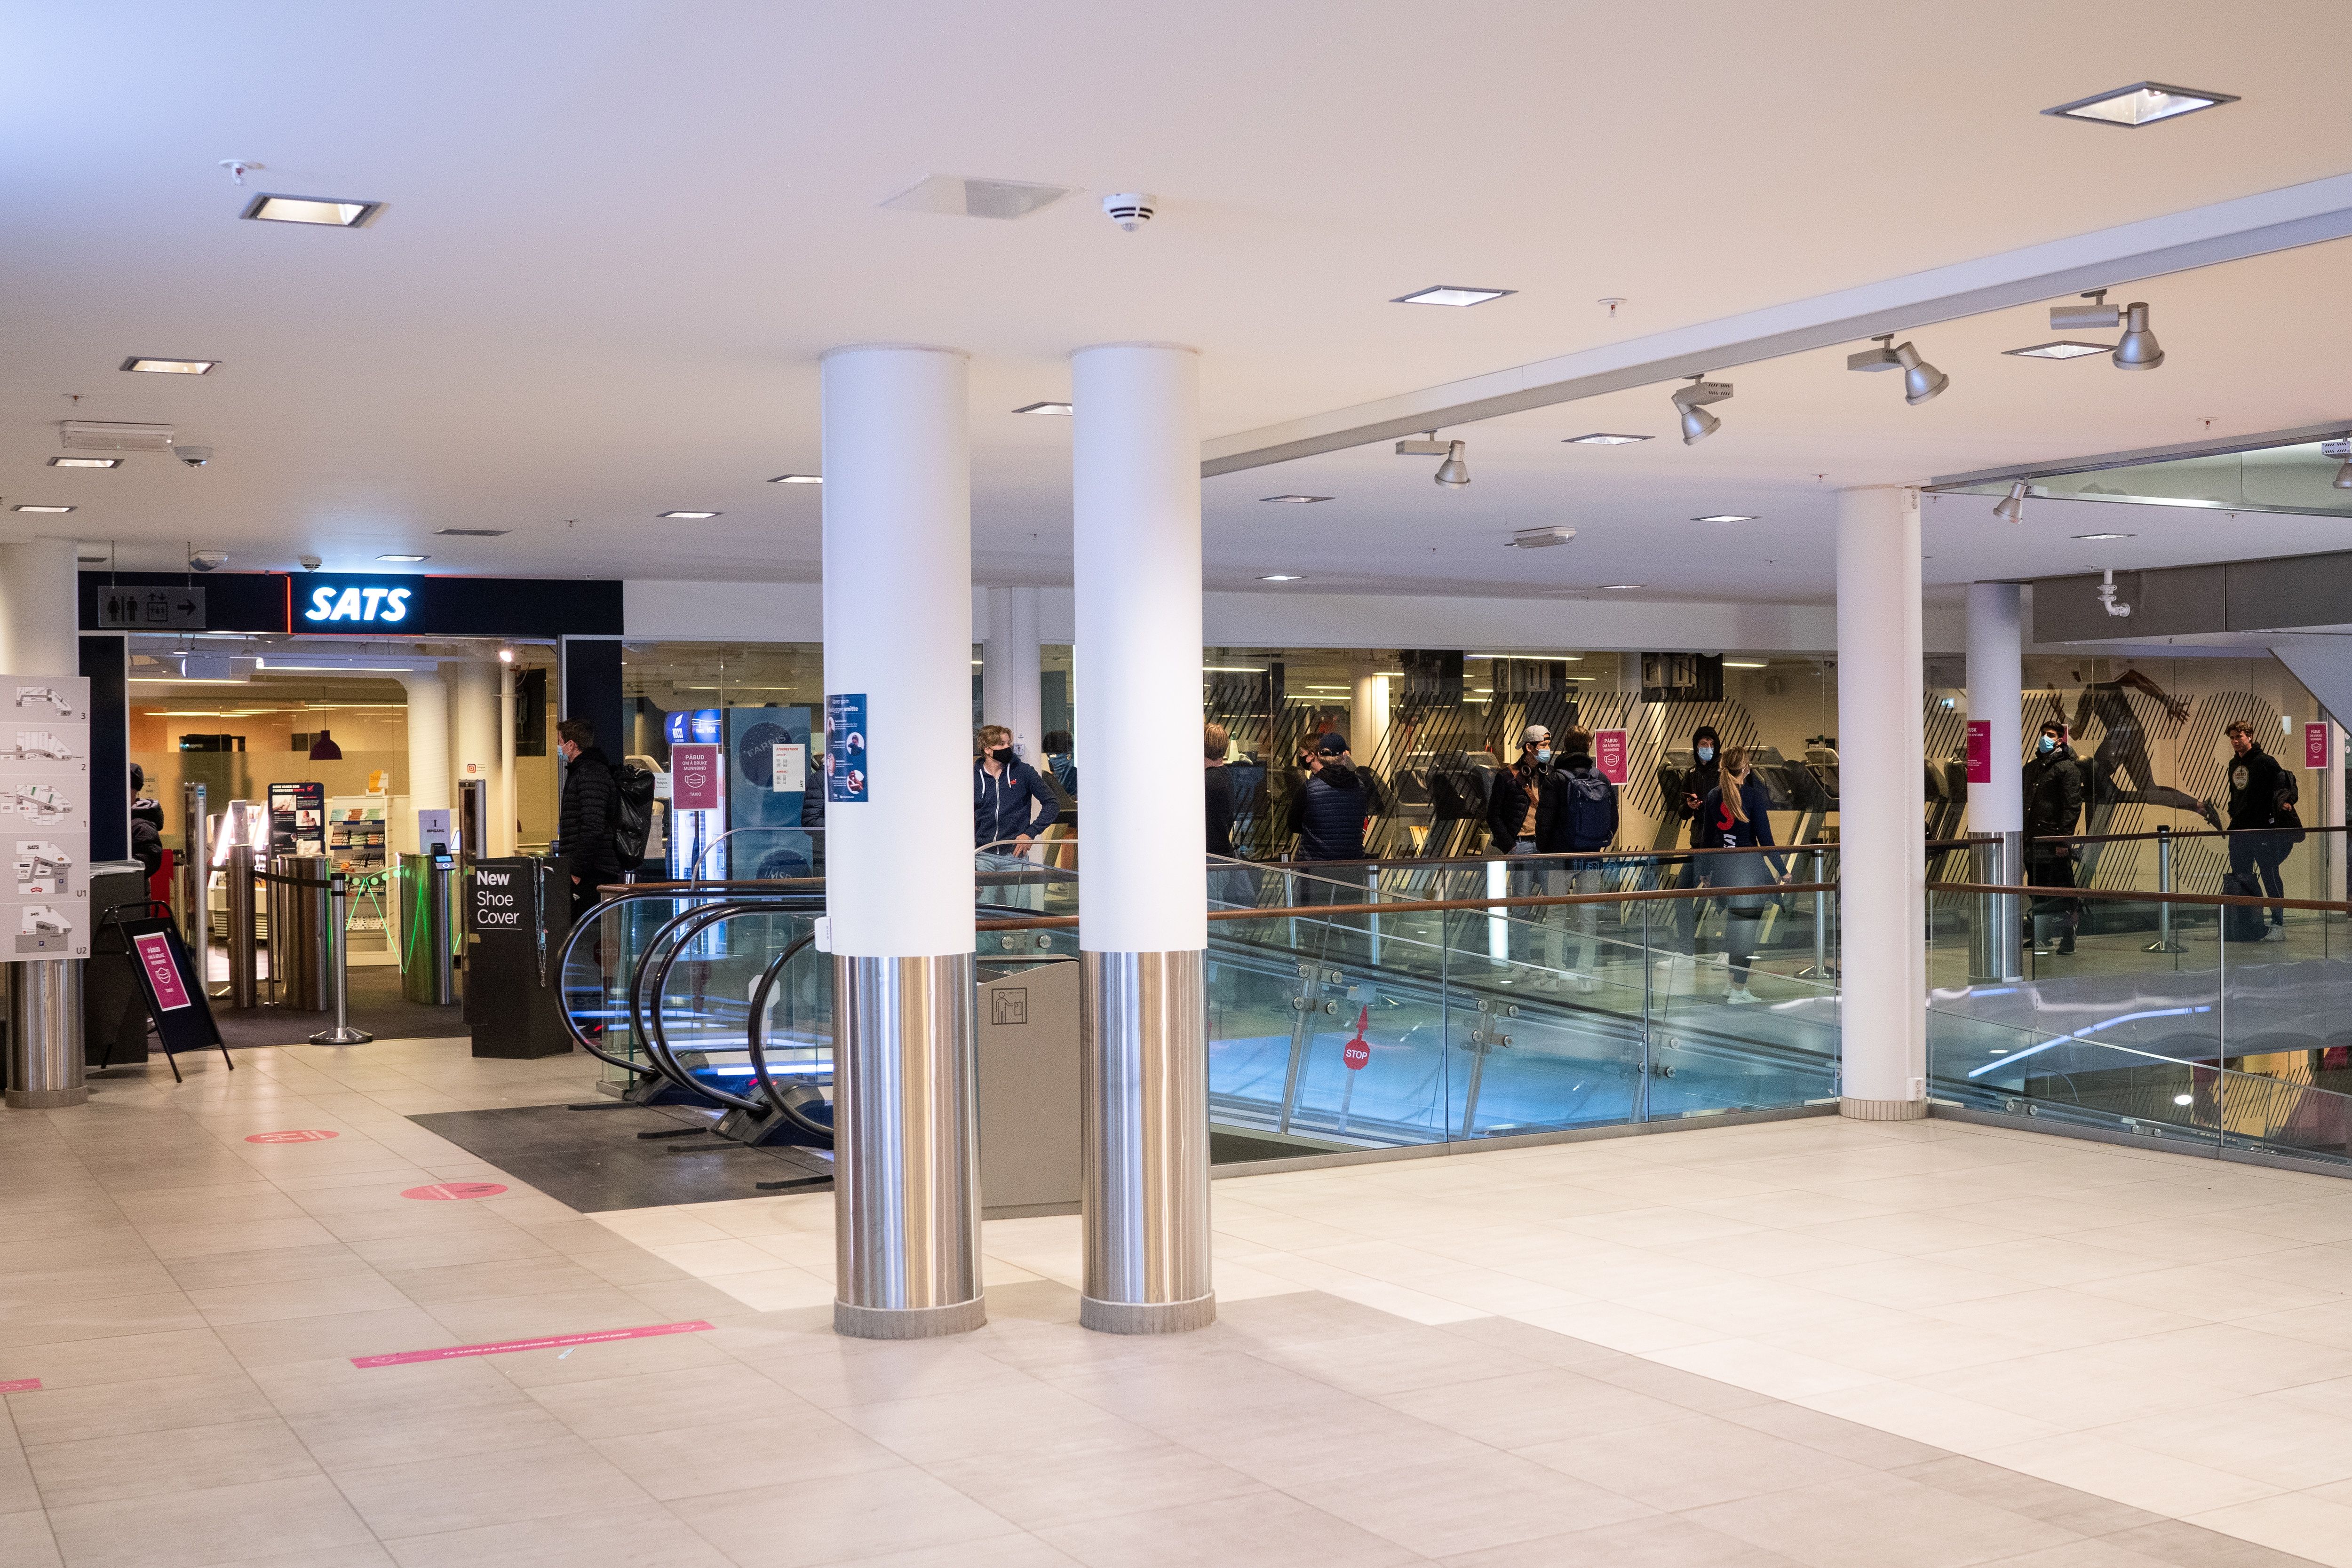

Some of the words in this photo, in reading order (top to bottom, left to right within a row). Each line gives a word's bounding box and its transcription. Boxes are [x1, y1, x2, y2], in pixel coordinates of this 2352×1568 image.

[305, 587, 411, 621] SATS
[672, 728, 683, 738] NOCCO
[477, 871, 510, 885] New
[477, 891, 513, 906] Shoe
[477, 909, 519, 924] Cover
[1346, 1049, 1367, 1059] STOP
